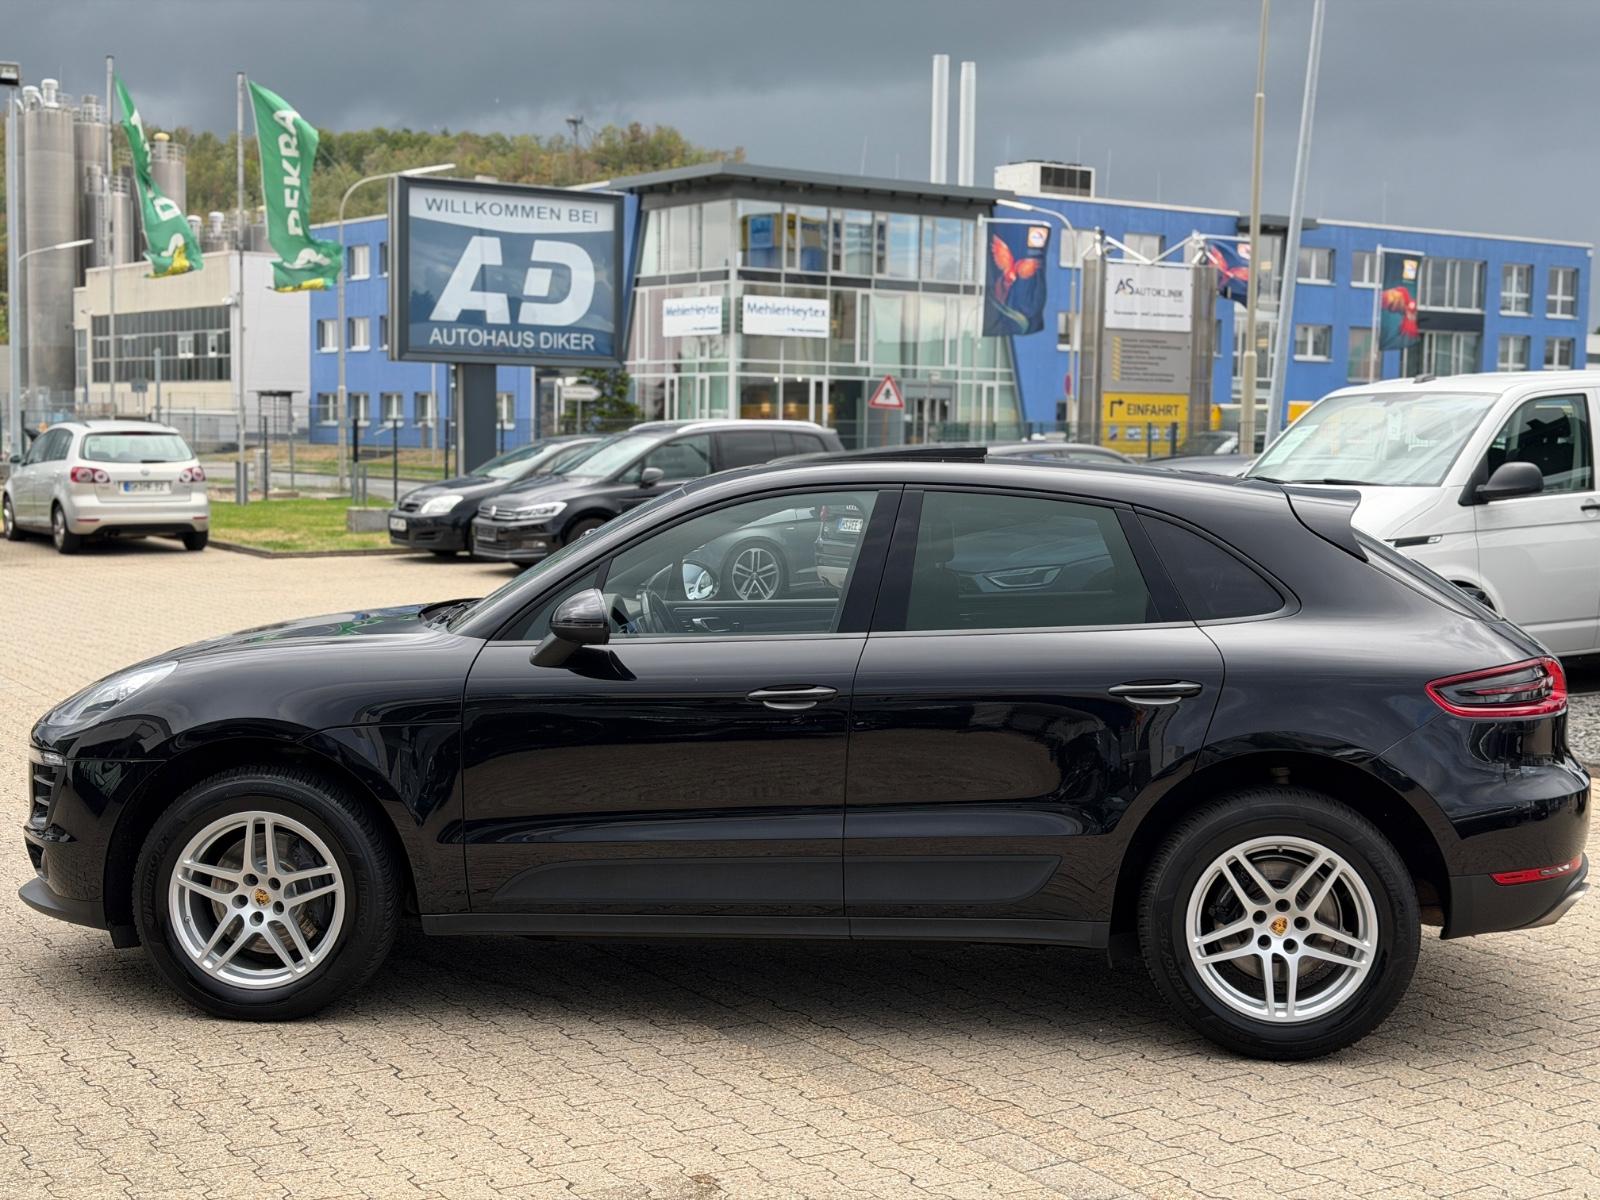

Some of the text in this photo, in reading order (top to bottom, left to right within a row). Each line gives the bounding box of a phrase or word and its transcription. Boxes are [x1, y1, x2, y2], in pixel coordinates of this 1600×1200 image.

[273, 109, 303, 236] DEKRA
[425, 197, 598, 224] WILLKOMMEN BEI
[1115, 277, 1184, 298] AS AUTOKLINIK
[746, 302, 826, 321] MehlerHeytex
[429, 327, 595, 350] AUTOHAUS DIKER
[1127, 403, 1180, 417] EINFAHRT
